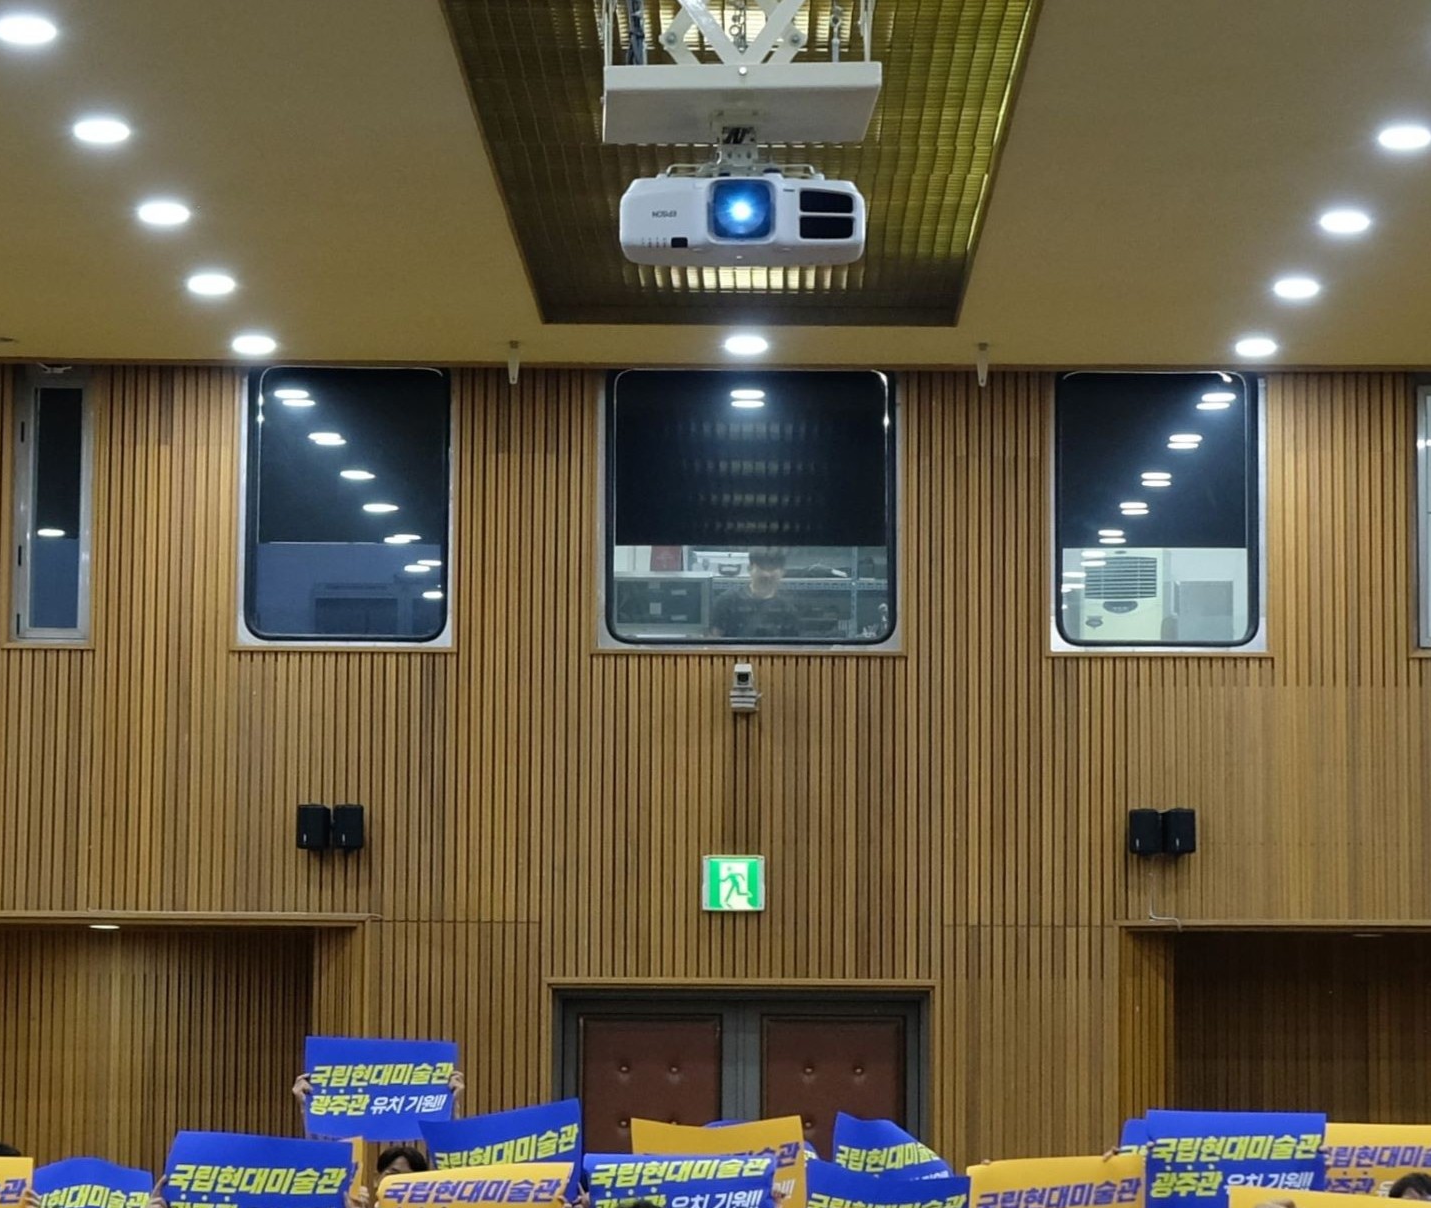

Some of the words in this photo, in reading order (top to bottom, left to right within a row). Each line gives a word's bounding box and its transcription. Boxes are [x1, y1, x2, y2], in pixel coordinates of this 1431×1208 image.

[310, 1063, 454, 1087] 국립현대미술관
[310, 1094, 371, 1116] 광주관
[371, 1096, 403, 1115] 유치
[407, 1094, 447, 1114] 기원!!
[1151, 1134, 1322, 1161] 국립현대미술관
[169, 1164, 348, 1195] 국립현대미술관
[590, 1157, 772, 1189] 국립현대미술관
[1150, 1171, 1223, 1198] 광주관
[383, 1178, 560, 1204] 국립현대미술관
